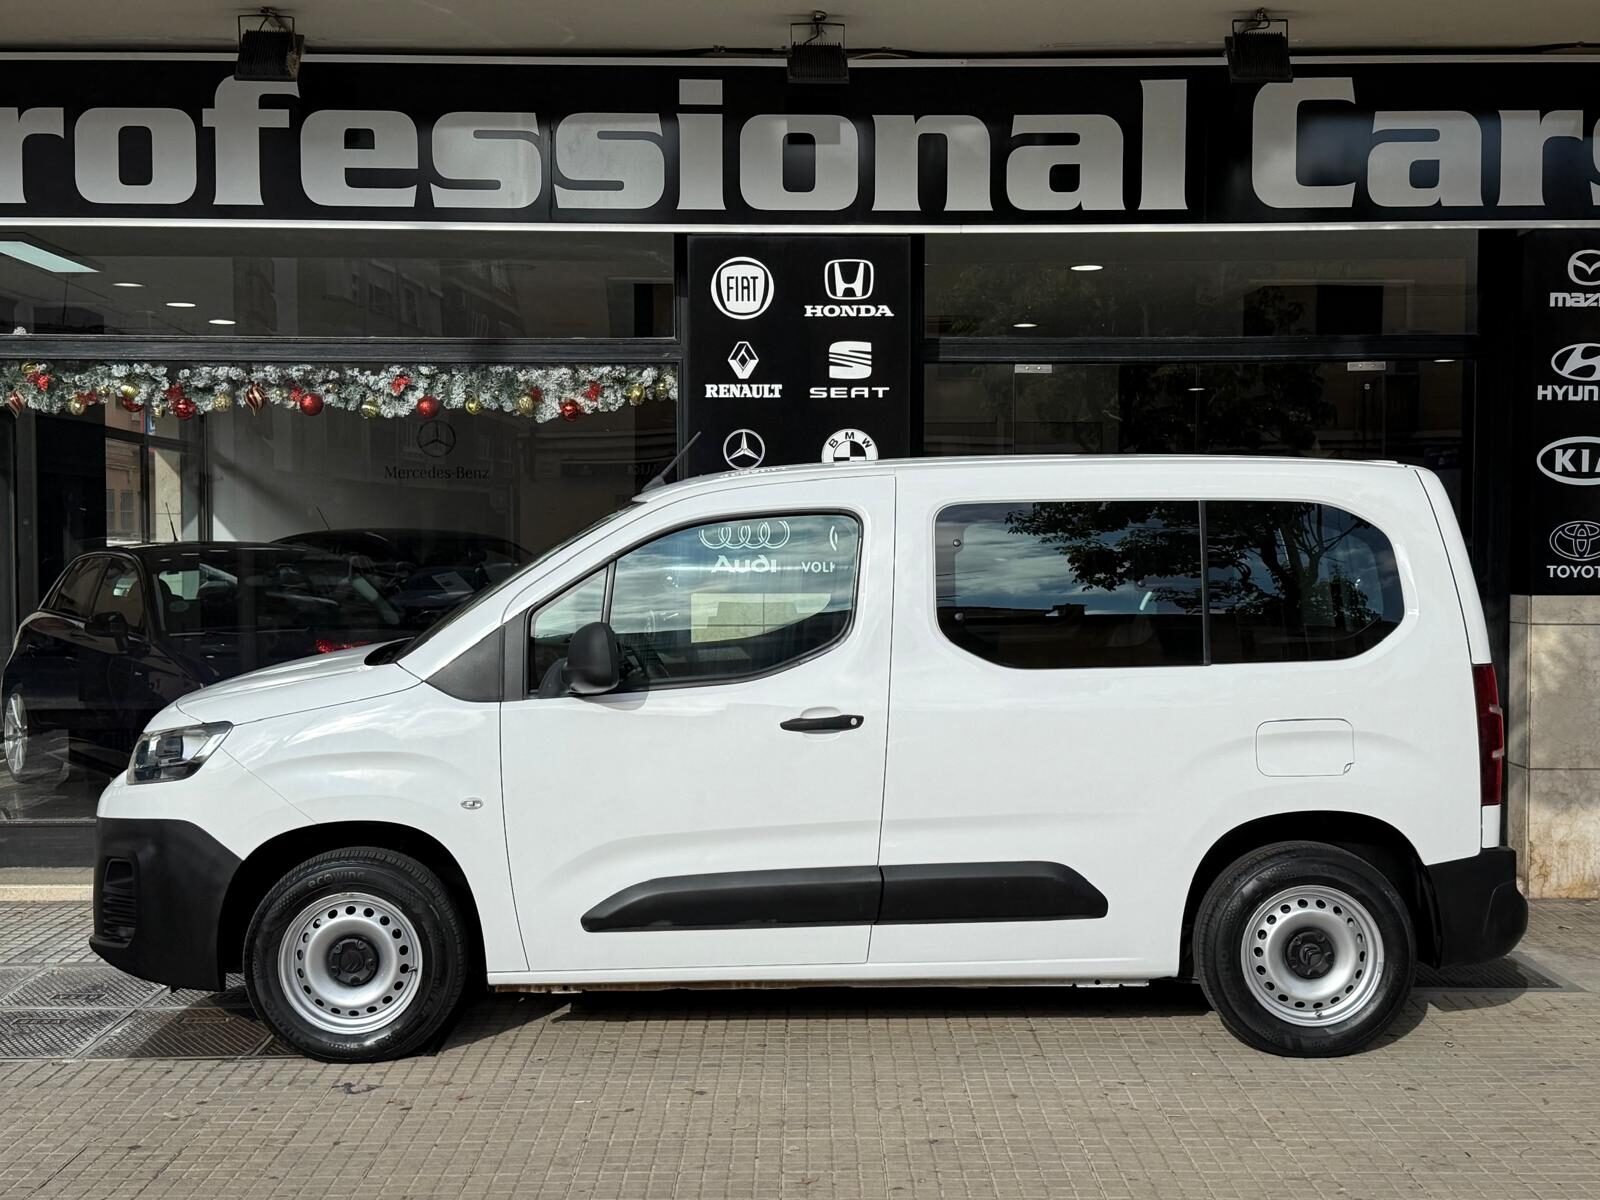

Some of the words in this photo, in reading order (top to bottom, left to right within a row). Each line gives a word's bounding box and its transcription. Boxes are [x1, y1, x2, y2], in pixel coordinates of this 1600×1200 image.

[1250, 78, 1600, 209] Car
[726, 276, 759, 302] FIAT
[1549, 292, 1600, 308] maz
[804, 304, 895, 317] HONDA
[704, 384, 783, 398] RENAULT
[809, 386, 890, 399] SEAT
[1537, 385, 1599, 401] HYUN
[828, 431, 873, 450] BMW
[384, 466, 489, 480] Mercedes-Benz
